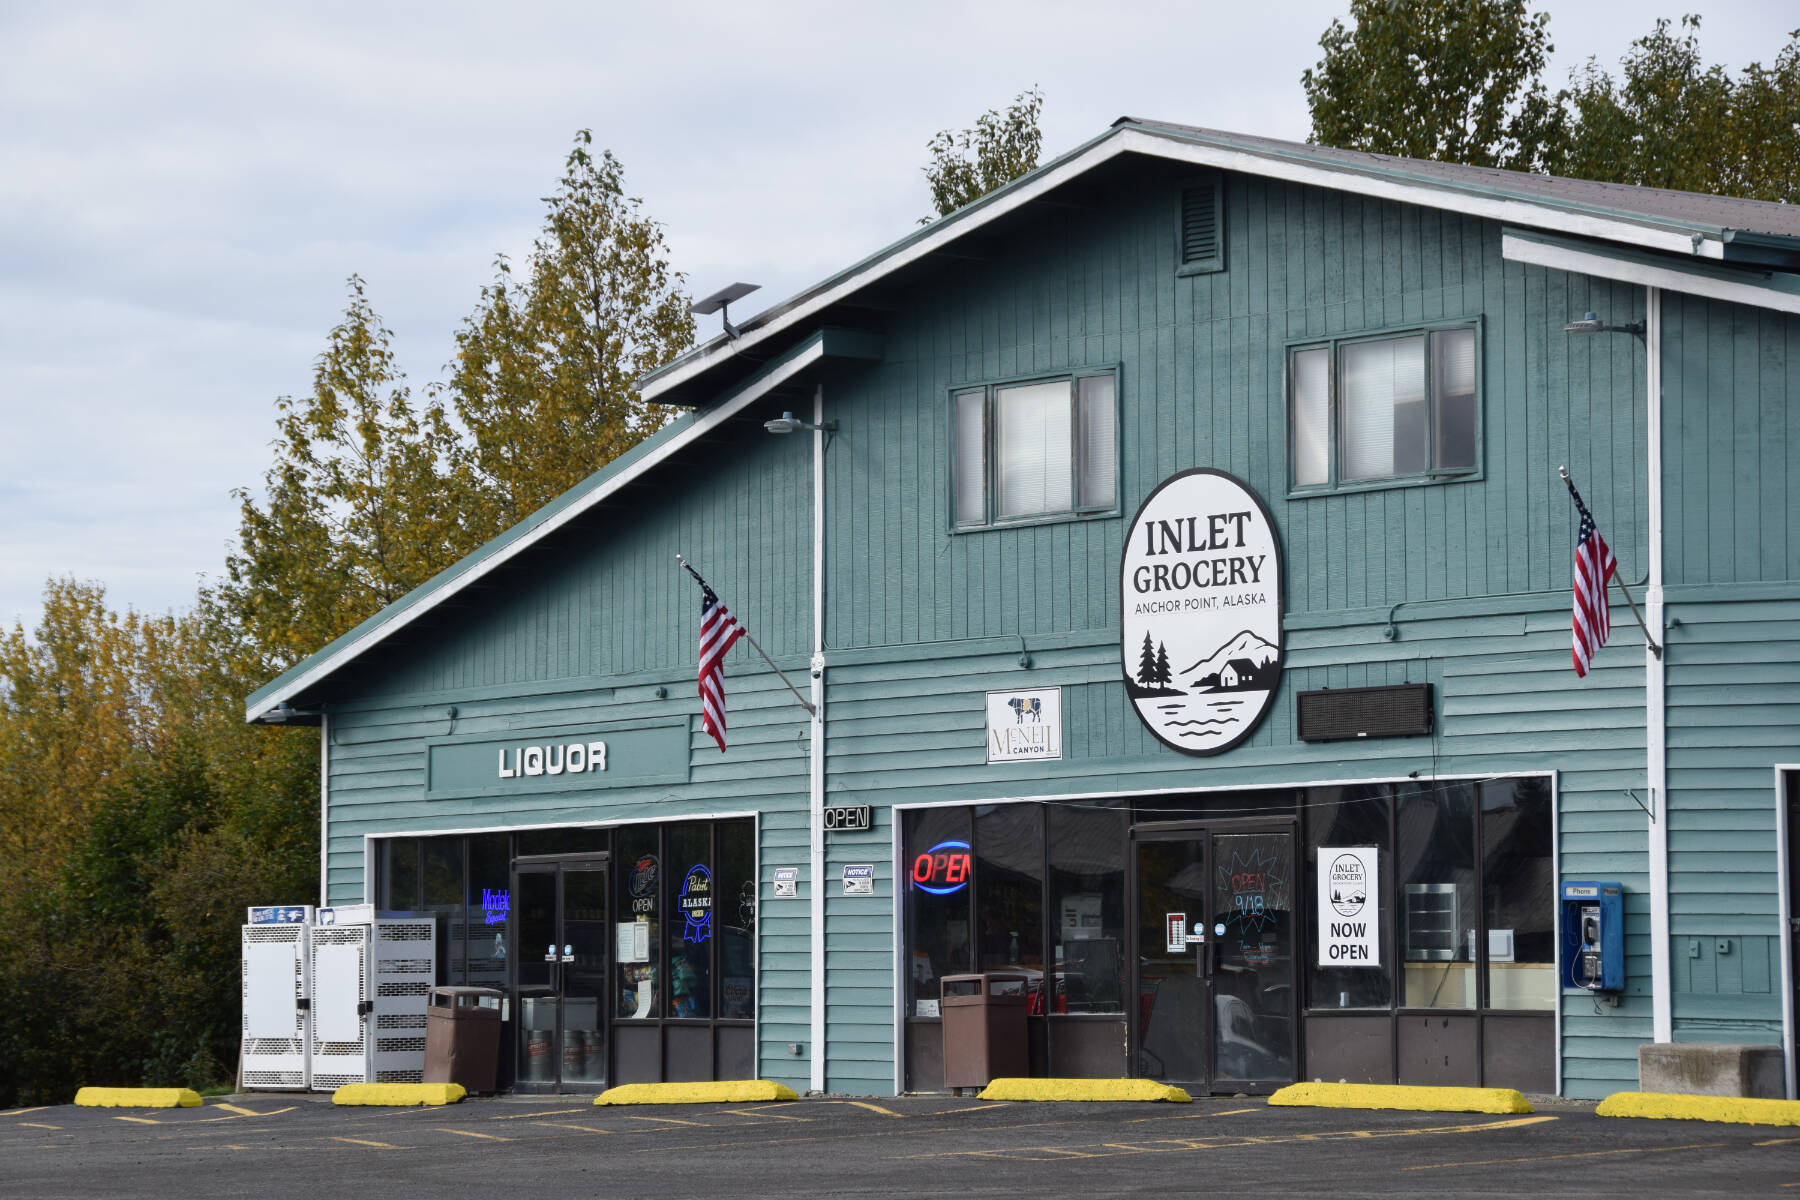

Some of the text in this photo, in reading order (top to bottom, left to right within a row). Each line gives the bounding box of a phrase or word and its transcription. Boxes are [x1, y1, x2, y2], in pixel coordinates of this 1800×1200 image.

[1145, 511, 1252, 556] INLET
[1133, 555, 1266, 594] GROCERY
[1135, 593, 1266, 615] ANCHOR POINT, ALASKA
[1012, 746, 1045, 754] CANYON
[498, 741, 606, 778] LIQUOR
[824, 808, 867, 828] OPEN
[847, 868, 868, 876] NOTICE
[1332, 873, 1363, 881] GROCERY
[1335, 864, 1360, 873] INLET
[688, 875, 708, 892] Pabst
[1231, 873, 1266, 893] OPEN
[632, 898, 653, 912] OPEN
[1235, 895, 1264, 915] 9/18
[1330, 923, 1367, 938] NOW
[1329, 944, 1369, 960] OPEN
